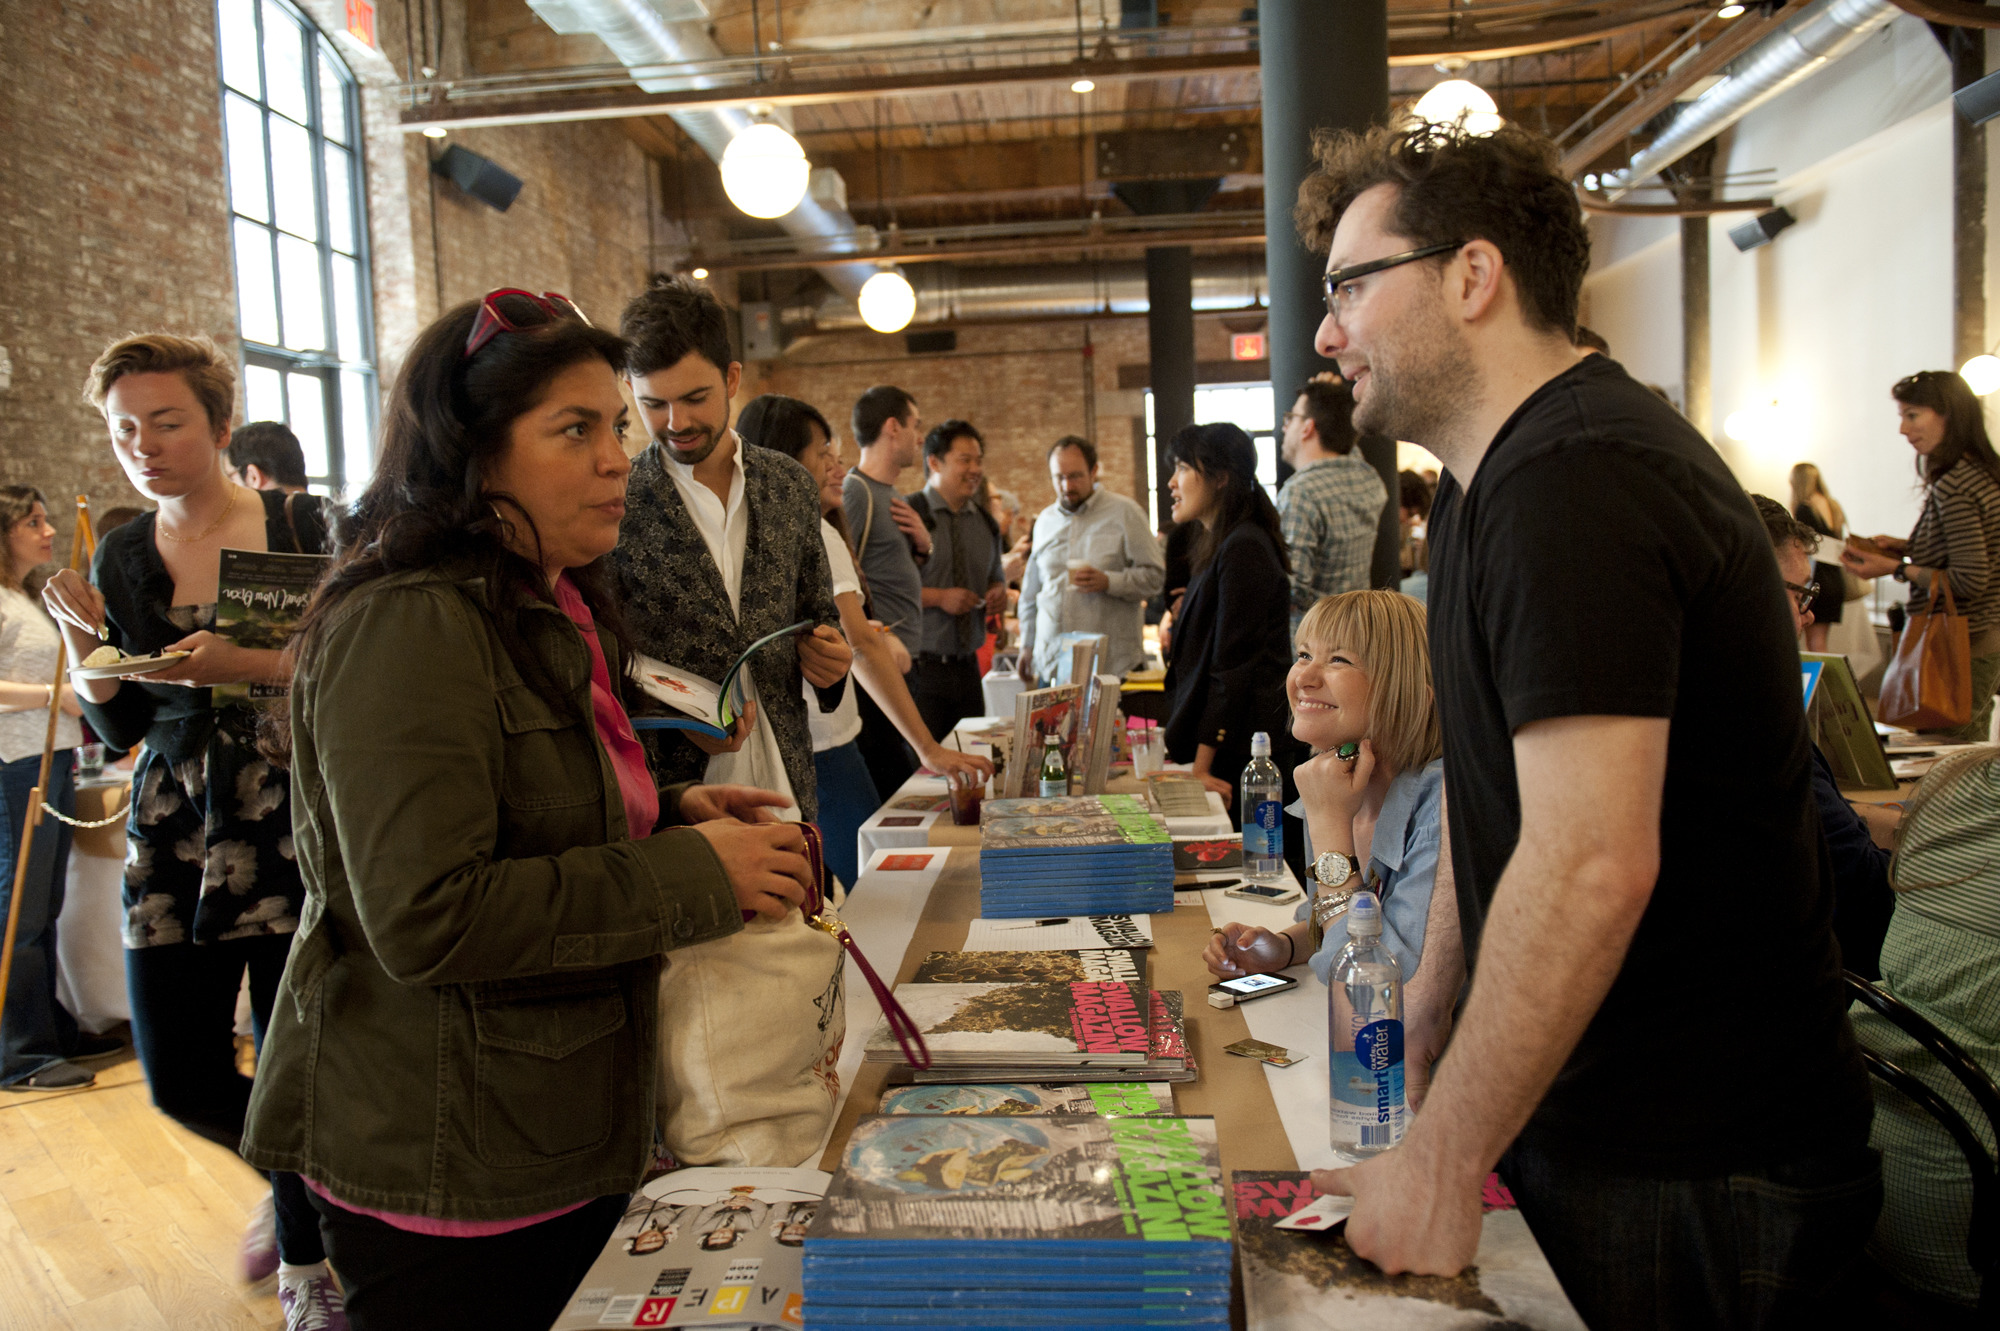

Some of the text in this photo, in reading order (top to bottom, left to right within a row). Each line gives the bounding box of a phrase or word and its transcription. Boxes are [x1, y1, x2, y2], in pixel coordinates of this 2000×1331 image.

[254, 591, 279, 610] Now
[1078, 950, 1114, 982] MAGA
[1104, 950, 1140, 982] SWALL
[1100, 982, 1149, 1052] SWALLOW
[1147, 1118, 1232, 1239] SWALLOW
